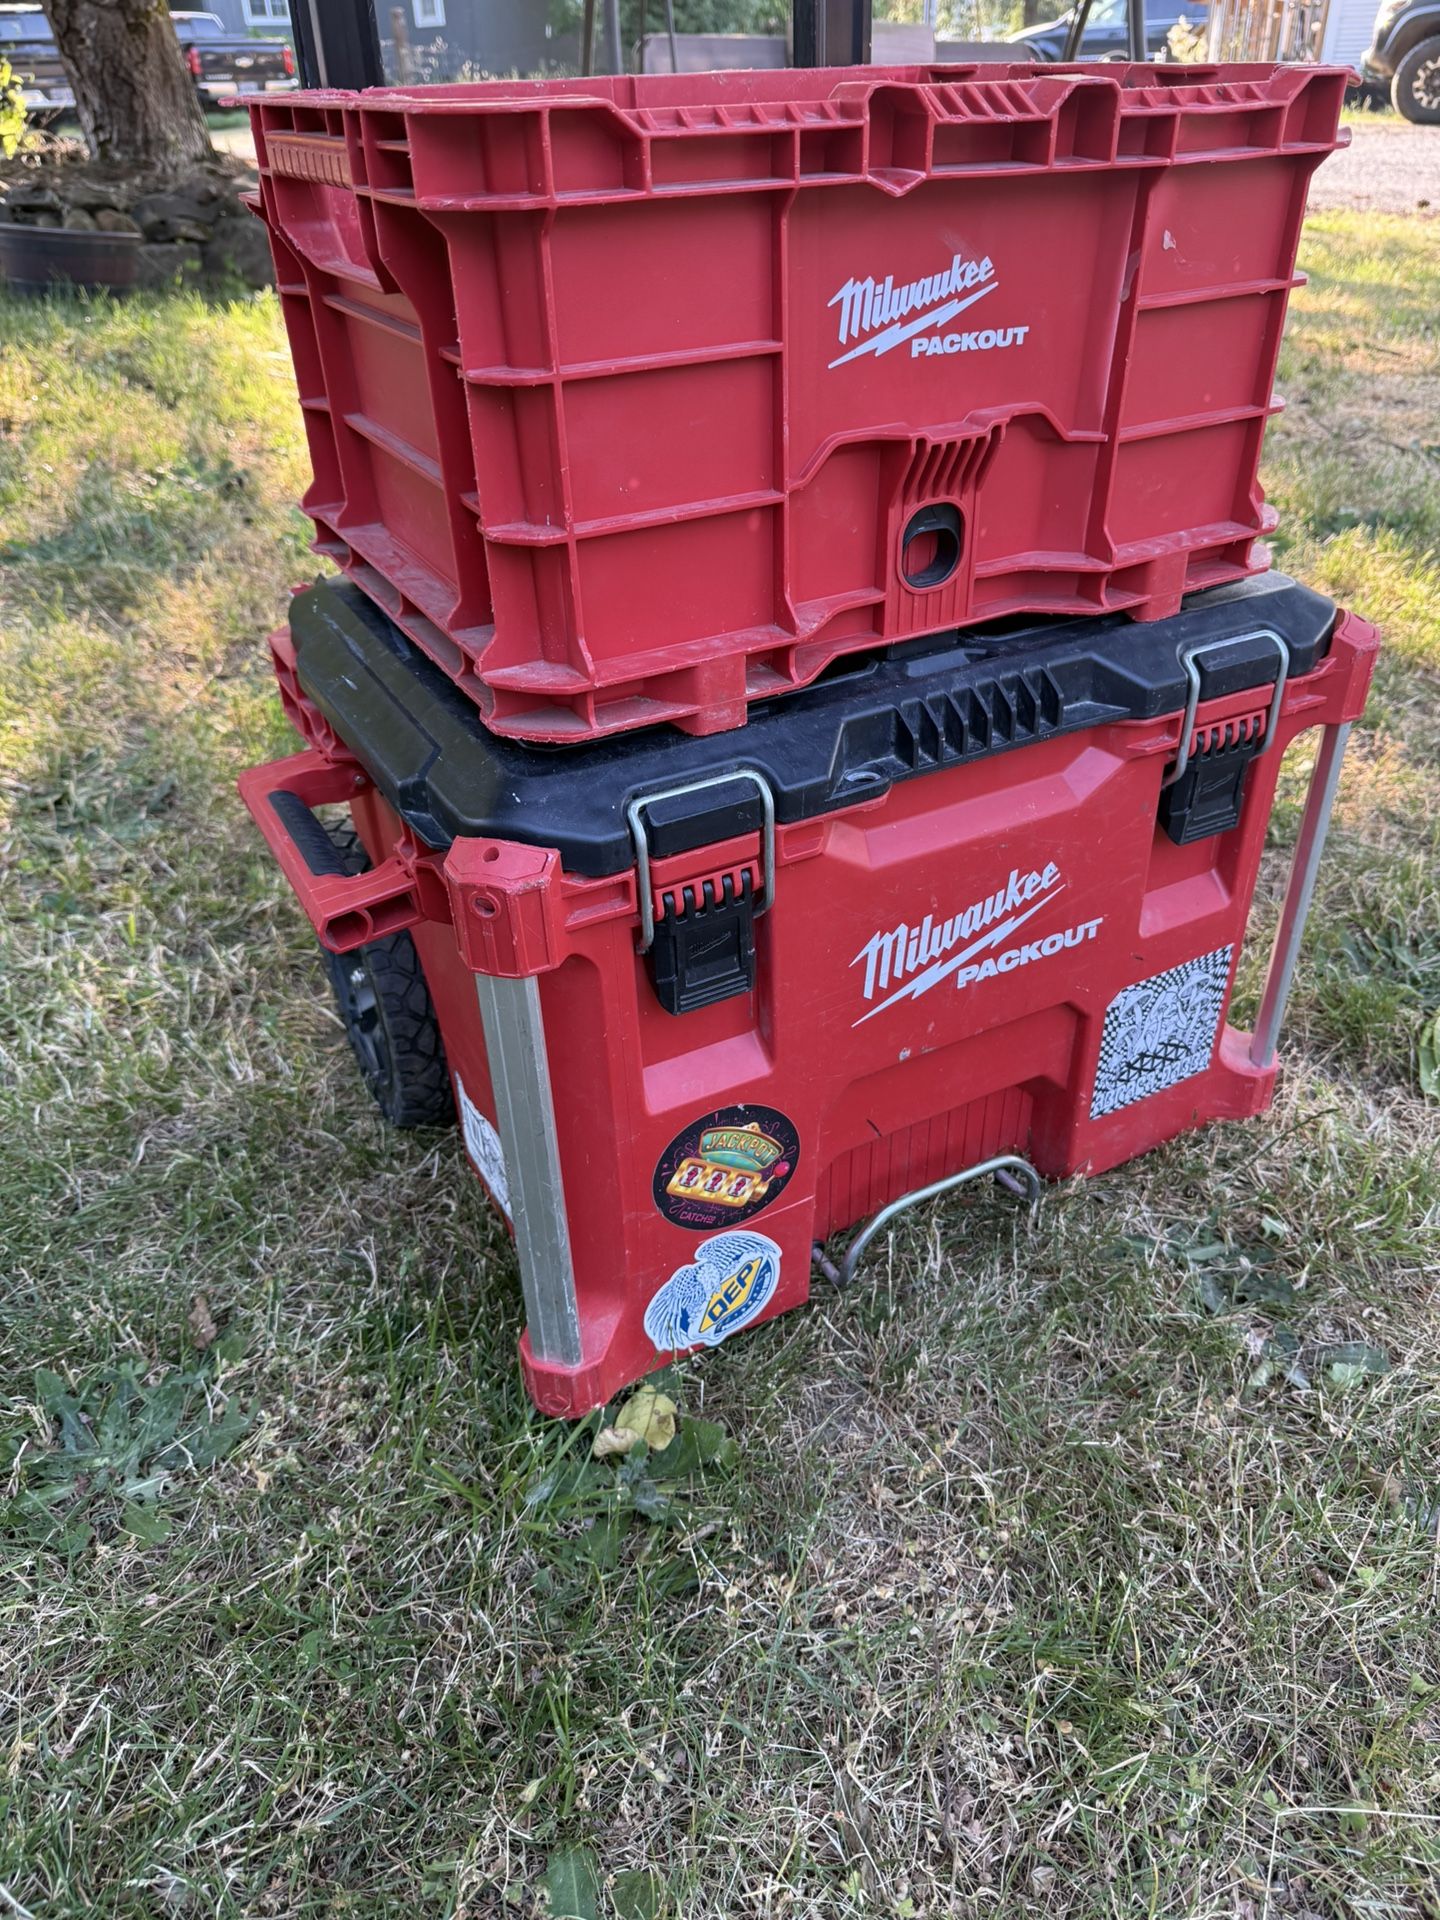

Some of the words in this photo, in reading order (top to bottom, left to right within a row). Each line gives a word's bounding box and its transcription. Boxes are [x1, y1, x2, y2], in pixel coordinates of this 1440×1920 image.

[827, 254, 995, 345] Milwaukee
[911, 326, 1030, 359] PACKOUT
[849, 861, 1061, 1000] Milwaukee
[957, 917, 1104, 989] PACKOUT
[706, 1133, 776, 1162] JACKPOT
